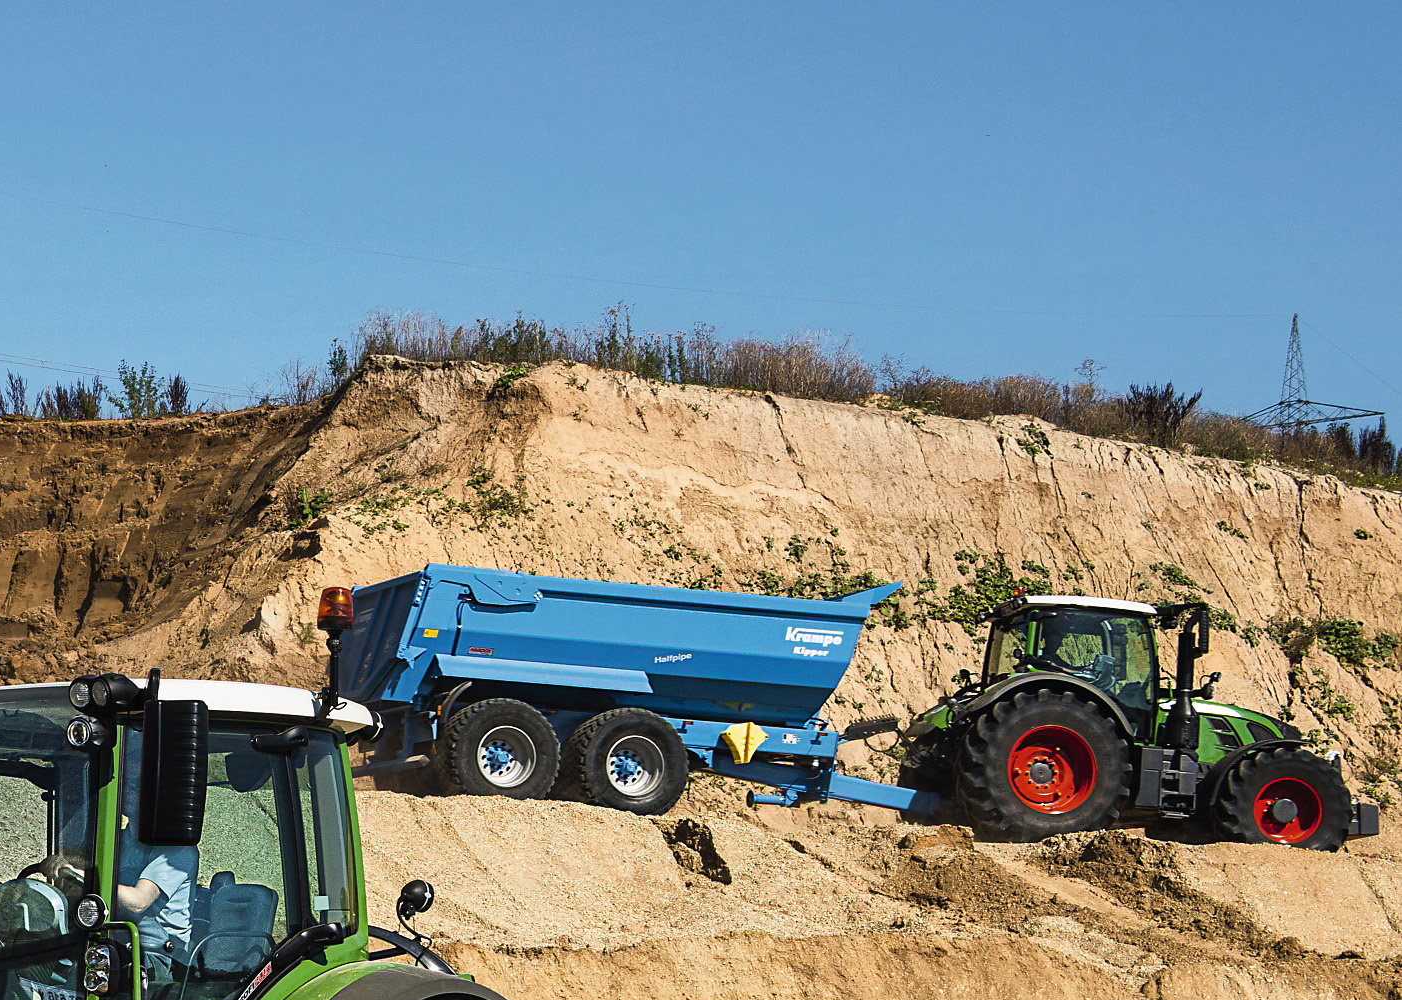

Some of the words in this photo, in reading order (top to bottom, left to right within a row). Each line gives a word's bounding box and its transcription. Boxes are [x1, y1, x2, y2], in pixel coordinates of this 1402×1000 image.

[785, 626, 844, 647] Krampe
[793, 646, 830, 657] Kipper
[654, 652, 693, 664] Halfpipe
